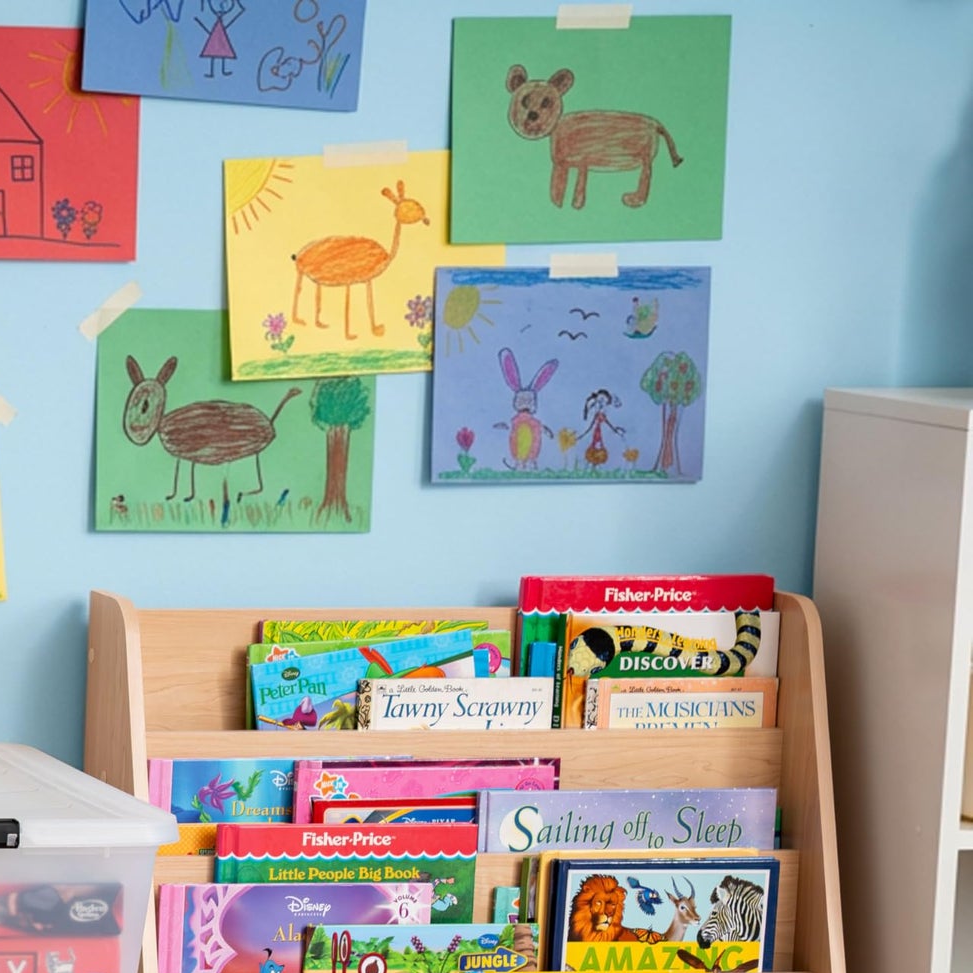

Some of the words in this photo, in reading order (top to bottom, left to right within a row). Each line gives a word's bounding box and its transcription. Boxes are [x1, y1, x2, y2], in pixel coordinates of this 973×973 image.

[604, 587, 692, 602] Fisher-Price
[619, 656, 713, 671] DISCOVER
[258, 684, 297, 706] Peter
[297, 678, 327, 696] Pan
[382, 694, 450, 727] Tawny
[453, 693, 543, 726] Scrawny
[617, 706, 644, 718] THE
[645, 700, 756, 718] MUSICIANS
[508, 805, 615, 852] Sailing
[623, 811, 652, 842] off
[647, 831, 664, 849] to
[672, 805, 743, 848] Sleep
[302, 831, 391, 846] Fisher-Price
[268, 867, 306, 881] Little
[308, 867, 356, 882] People
[358, 867, 382, 881] Big
[383, 866, 421, 880] Book
[398, 902, 409, 919] 6
[464, 954, 518, 970] JUNGLE
